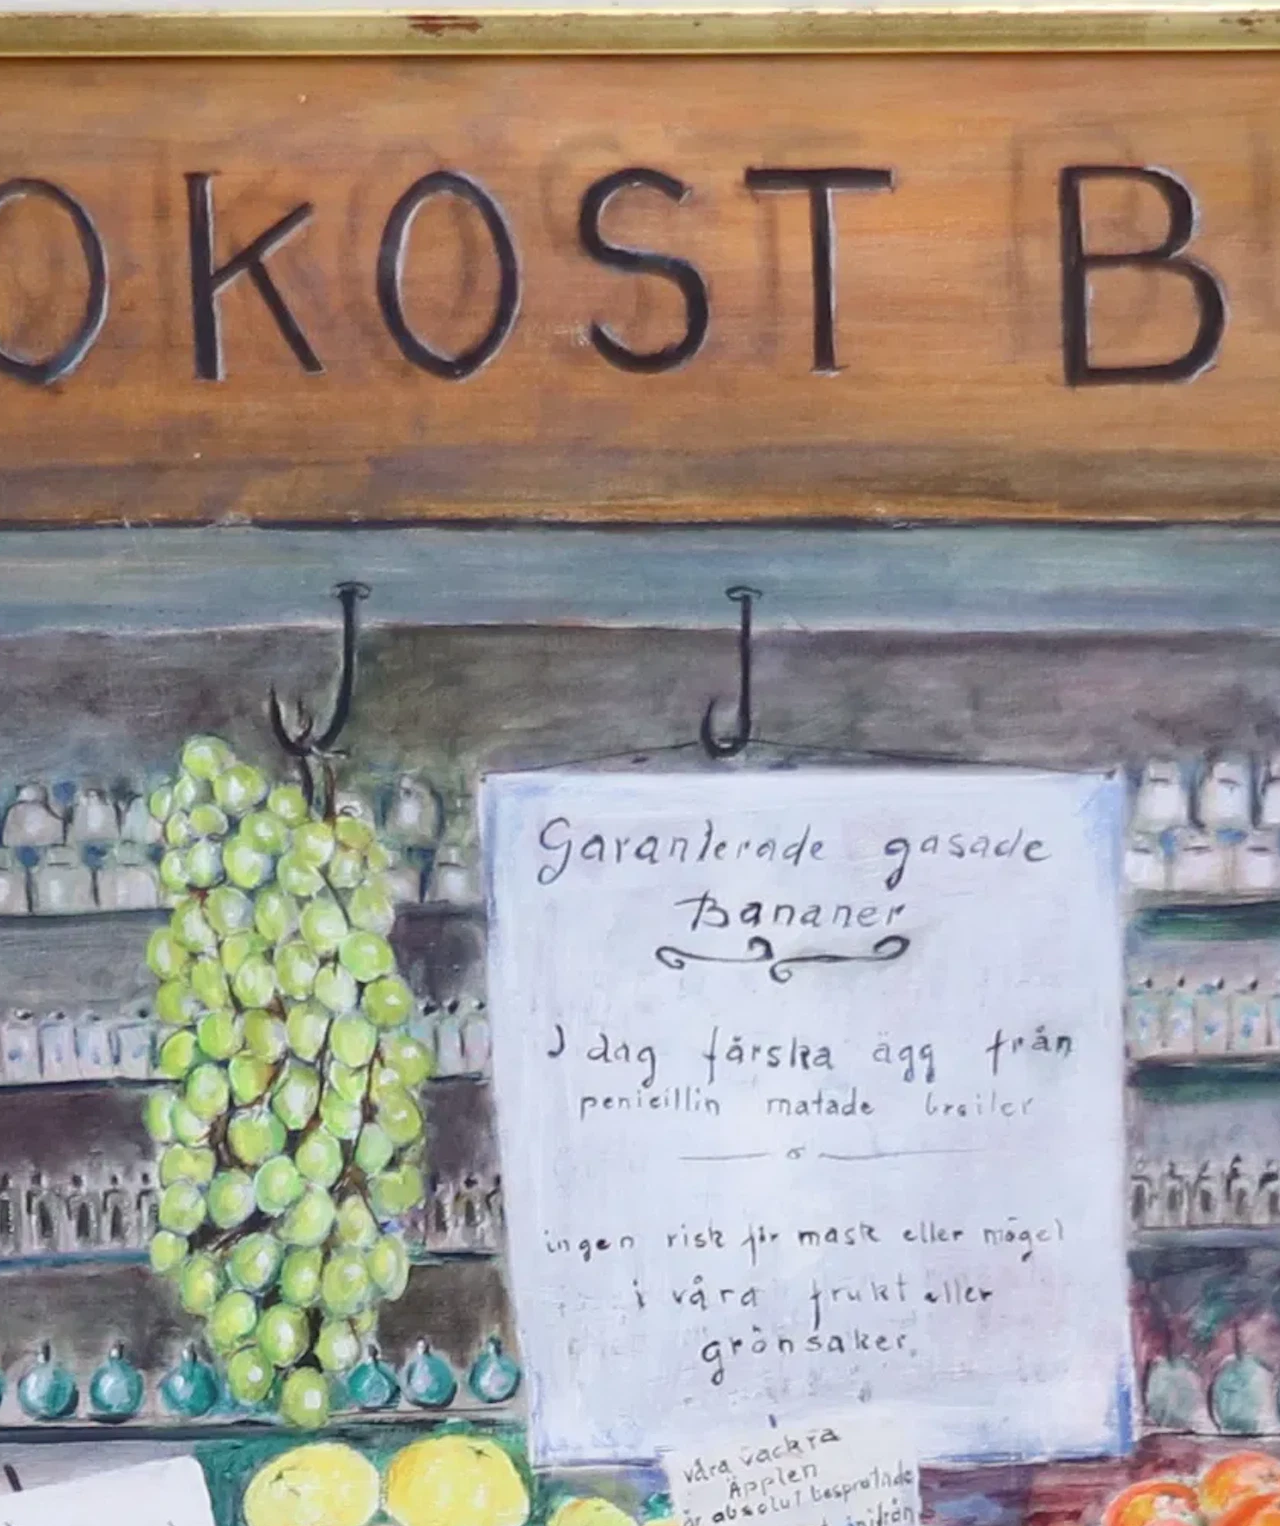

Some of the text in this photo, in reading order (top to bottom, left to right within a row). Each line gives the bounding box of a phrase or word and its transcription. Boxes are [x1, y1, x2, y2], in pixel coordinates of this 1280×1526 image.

[536, 816, 1053, 890] Garanterade gasade
[673, 890, 907, 932] Bananer
[586, 1025, 657, 1087] dag
[872, 1031, 936, 1083] ägg
[986, 1025, 1075, 1076] från
[766, 1087, 876, 1118] matade
[543, 1229, 635, 1263] ingen
[666, 1223, 726, 1250] risk
[902, 1218, 964, 1244] eller
[671, 1274, 760, 1308] våra
[808, 1273, 908, 1332] frukt
[923, 1276, 995, 1305] eller
[739, 1427, 842, 1467] vackra
